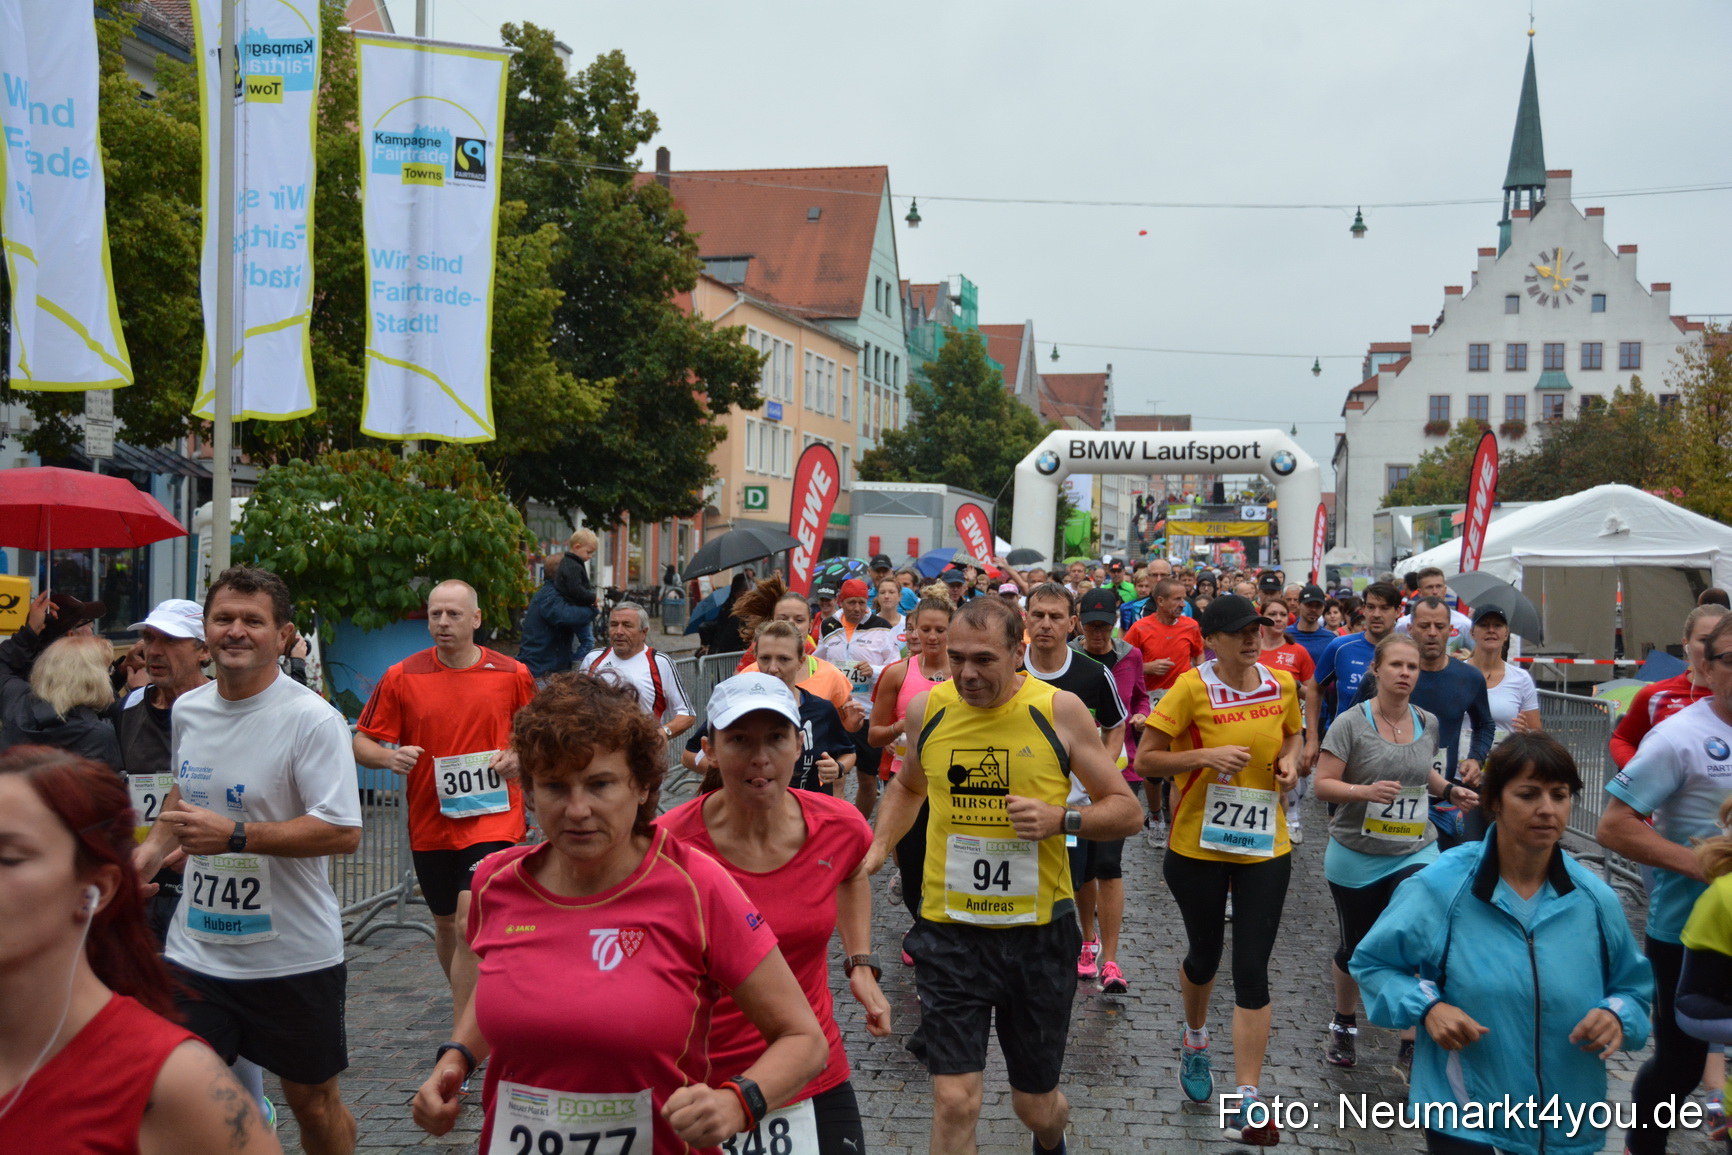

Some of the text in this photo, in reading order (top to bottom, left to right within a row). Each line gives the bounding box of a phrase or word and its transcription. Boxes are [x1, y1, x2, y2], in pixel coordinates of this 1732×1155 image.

[375, 132, 442, 149] Kampagne
[374, 145, 449, 164] Fairtrade
[404, 168, 442, 181] Towns
[455, 171, 485, 180] FAIRTRADE
[371, 248, 463, 274] Wir sind
[372, 280, 482, 307] Fairtrade-
[376, 312, 438, 333] Stadt!
[1068, 440, 1261, 464] BMW Laufsport
[747, 489, 765, 506] D
[1463, 453, 1494, 572] REWE
[792, 460, 832, 583] REWE
[1206, 524, 1229, 533] ZIEL
[1213, 711, 1246, 725] MAX
[1249, 705, 1283, 720] BÖGL
[443, 767, 501, 796] 3010
[952, 796, 1009, 811] HIRSCH
[1381, 798, 1419, 820] 217
[952, 814, 1009, 823] APOTHEKE
[1211, 801, 1268, 831] 2741
[1381, 824, 1411, 835] Kerstin
[953, 843, 981, 852] NeuerMarkt
[986, 841, 1031, 852] BOCK
[1223, 832, 1255, 847] Margit
[213, 855, 259, 868] BOCK
[973, 858, 1012, 891] 94
[193, 870, 261, 910] 2742
[966, 898, 1014, 912] Andreas
[204, 915, 242, 932] Hubert
[508, 1101, 549, 1117] NeuerMarkt
[558, 1097, 637, 1117] BOCK
